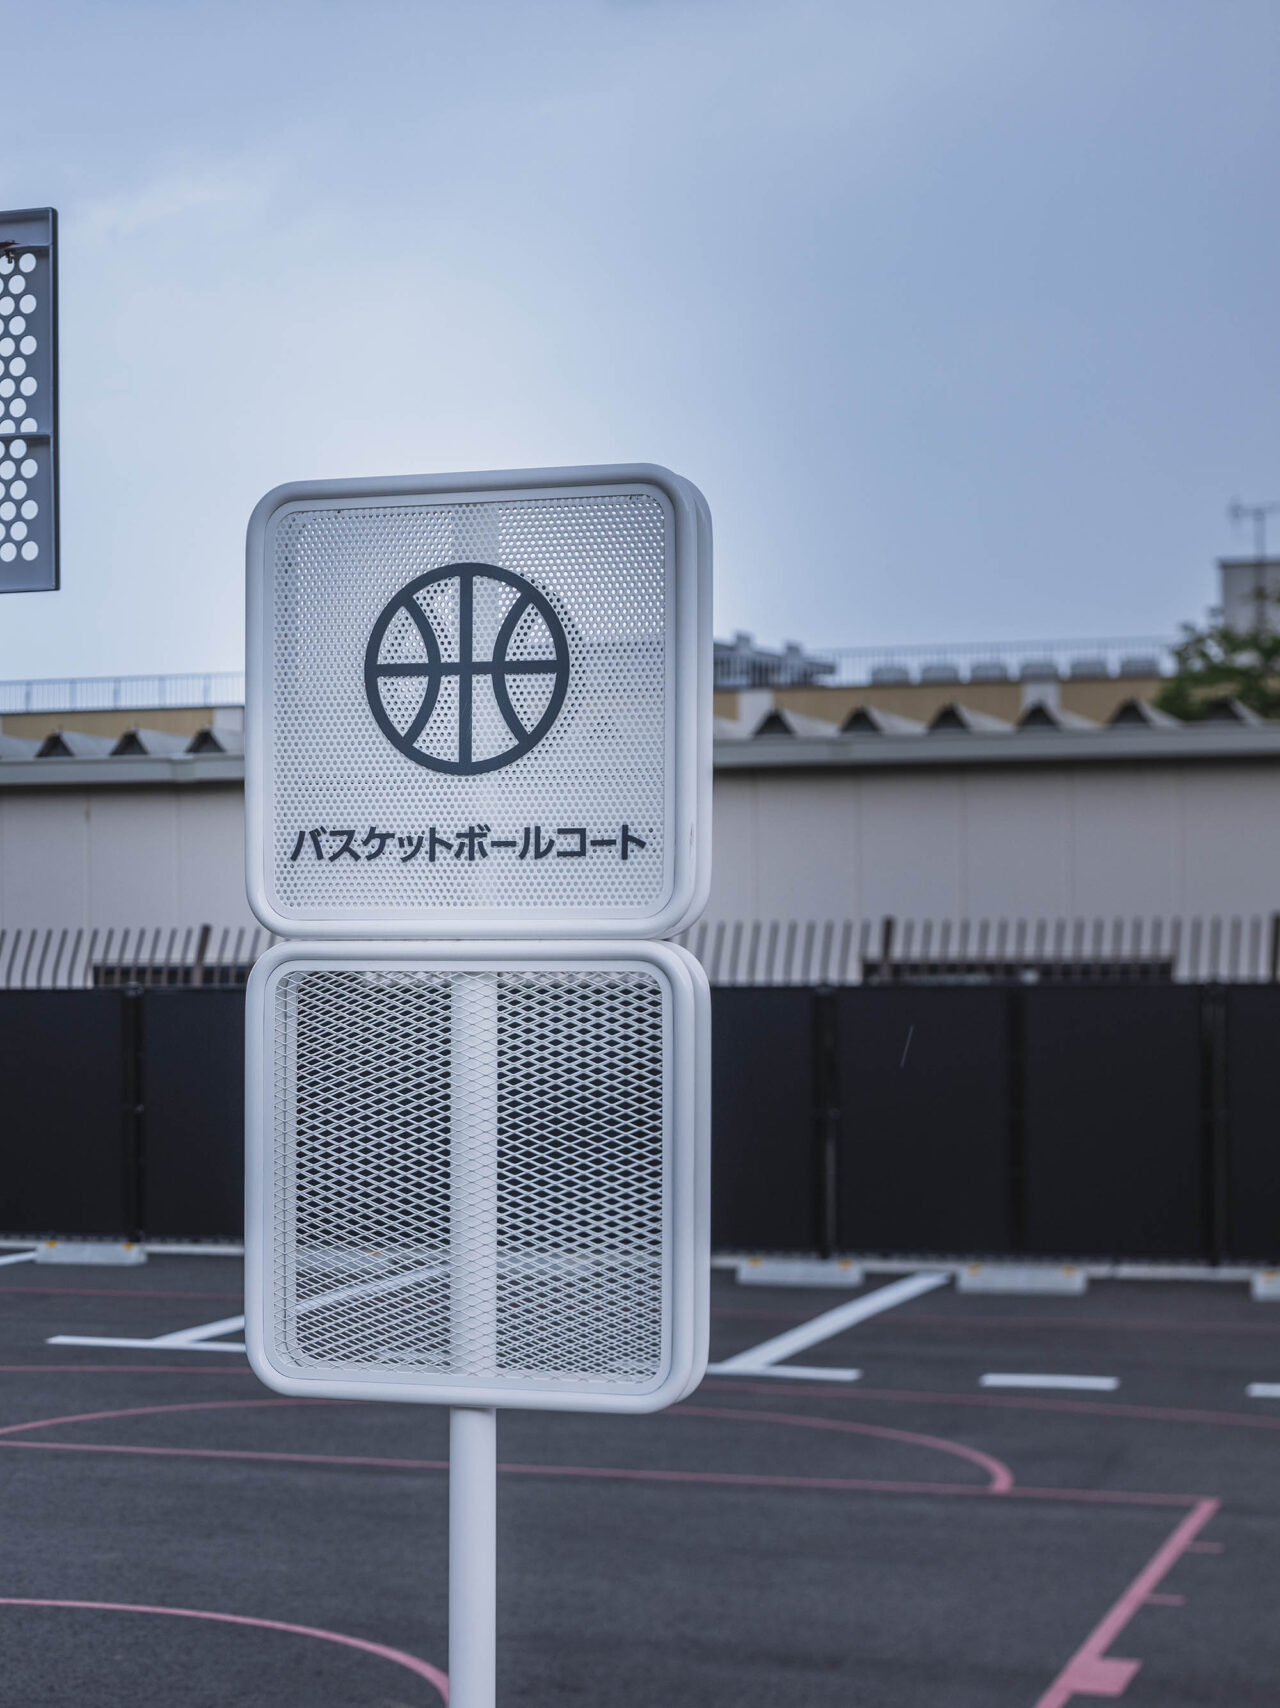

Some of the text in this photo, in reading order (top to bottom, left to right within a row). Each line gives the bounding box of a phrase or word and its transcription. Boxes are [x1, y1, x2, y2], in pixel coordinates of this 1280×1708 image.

[289, 823, 648, 863] バスケットボールコート
